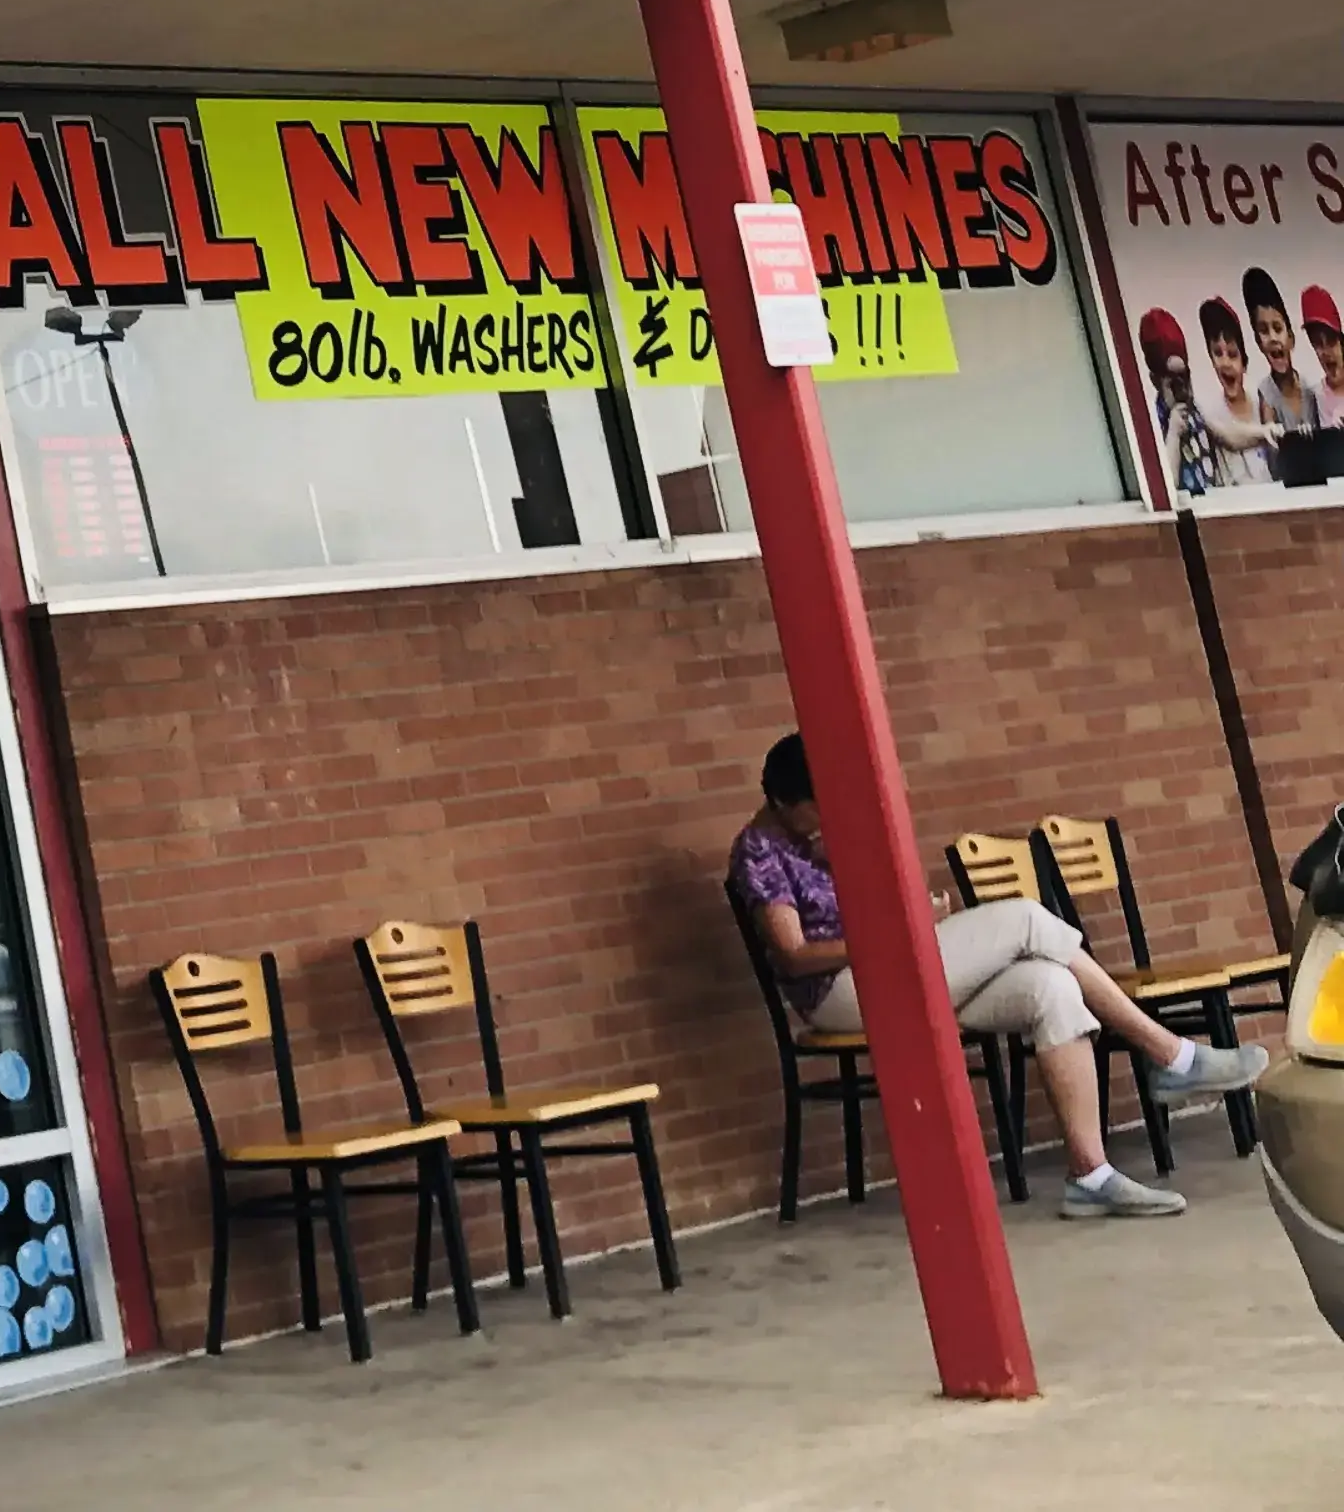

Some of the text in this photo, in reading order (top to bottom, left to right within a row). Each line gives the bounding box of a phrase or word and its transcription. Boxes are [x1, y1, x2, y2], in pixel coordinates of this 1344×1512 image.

[276, 120, 593, 299] NEW
[593, 128, 1058, 291] MHINES
[1126, 140, 1283, 226] After
[412, 302, 595, 380] WASHERS
